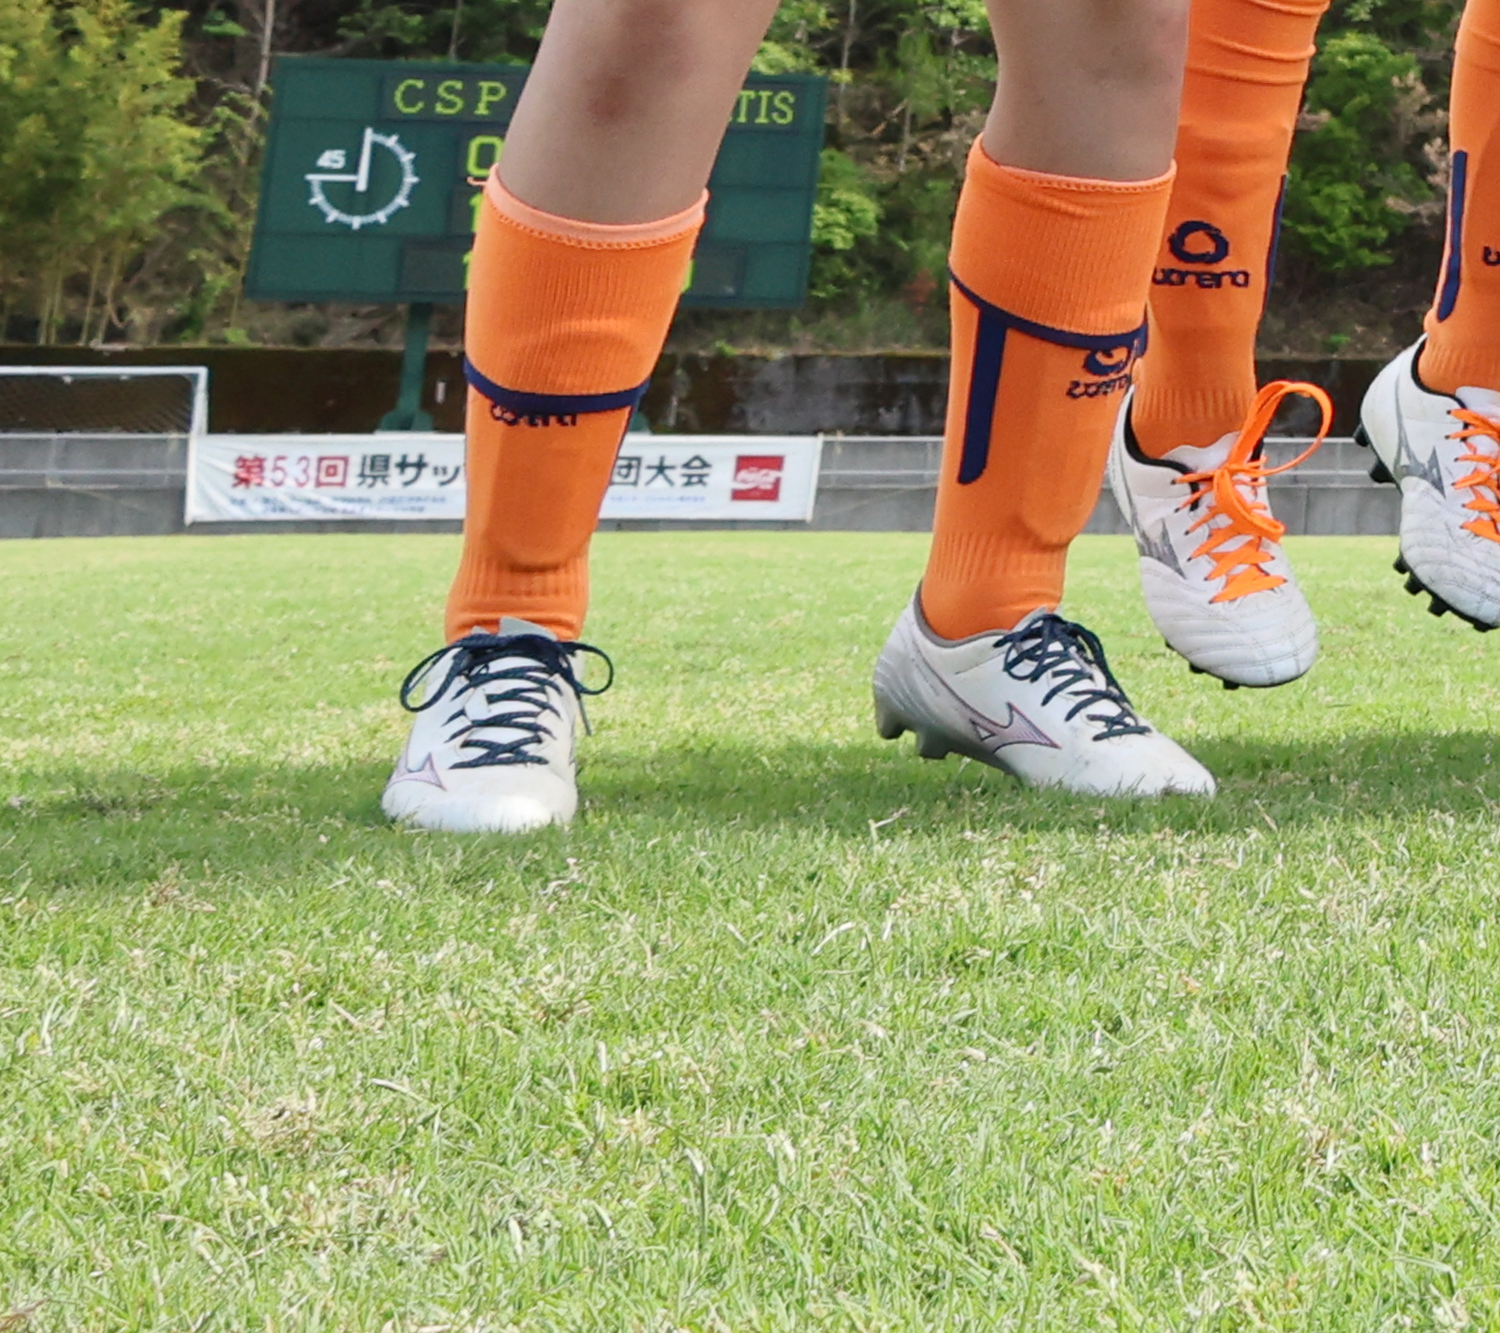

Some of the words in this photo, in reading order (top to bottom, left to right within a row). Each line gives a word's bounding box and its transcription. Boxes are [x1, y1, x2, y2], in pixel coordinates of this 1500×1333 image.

[394, 78, 507, 116] CSP
[733, 90, 796, 126] TIS
[231, 454, 350, 489] 第53回
[357, 454, 462, 489] 県サッ
[610, 454, 713, 488] 団大会
